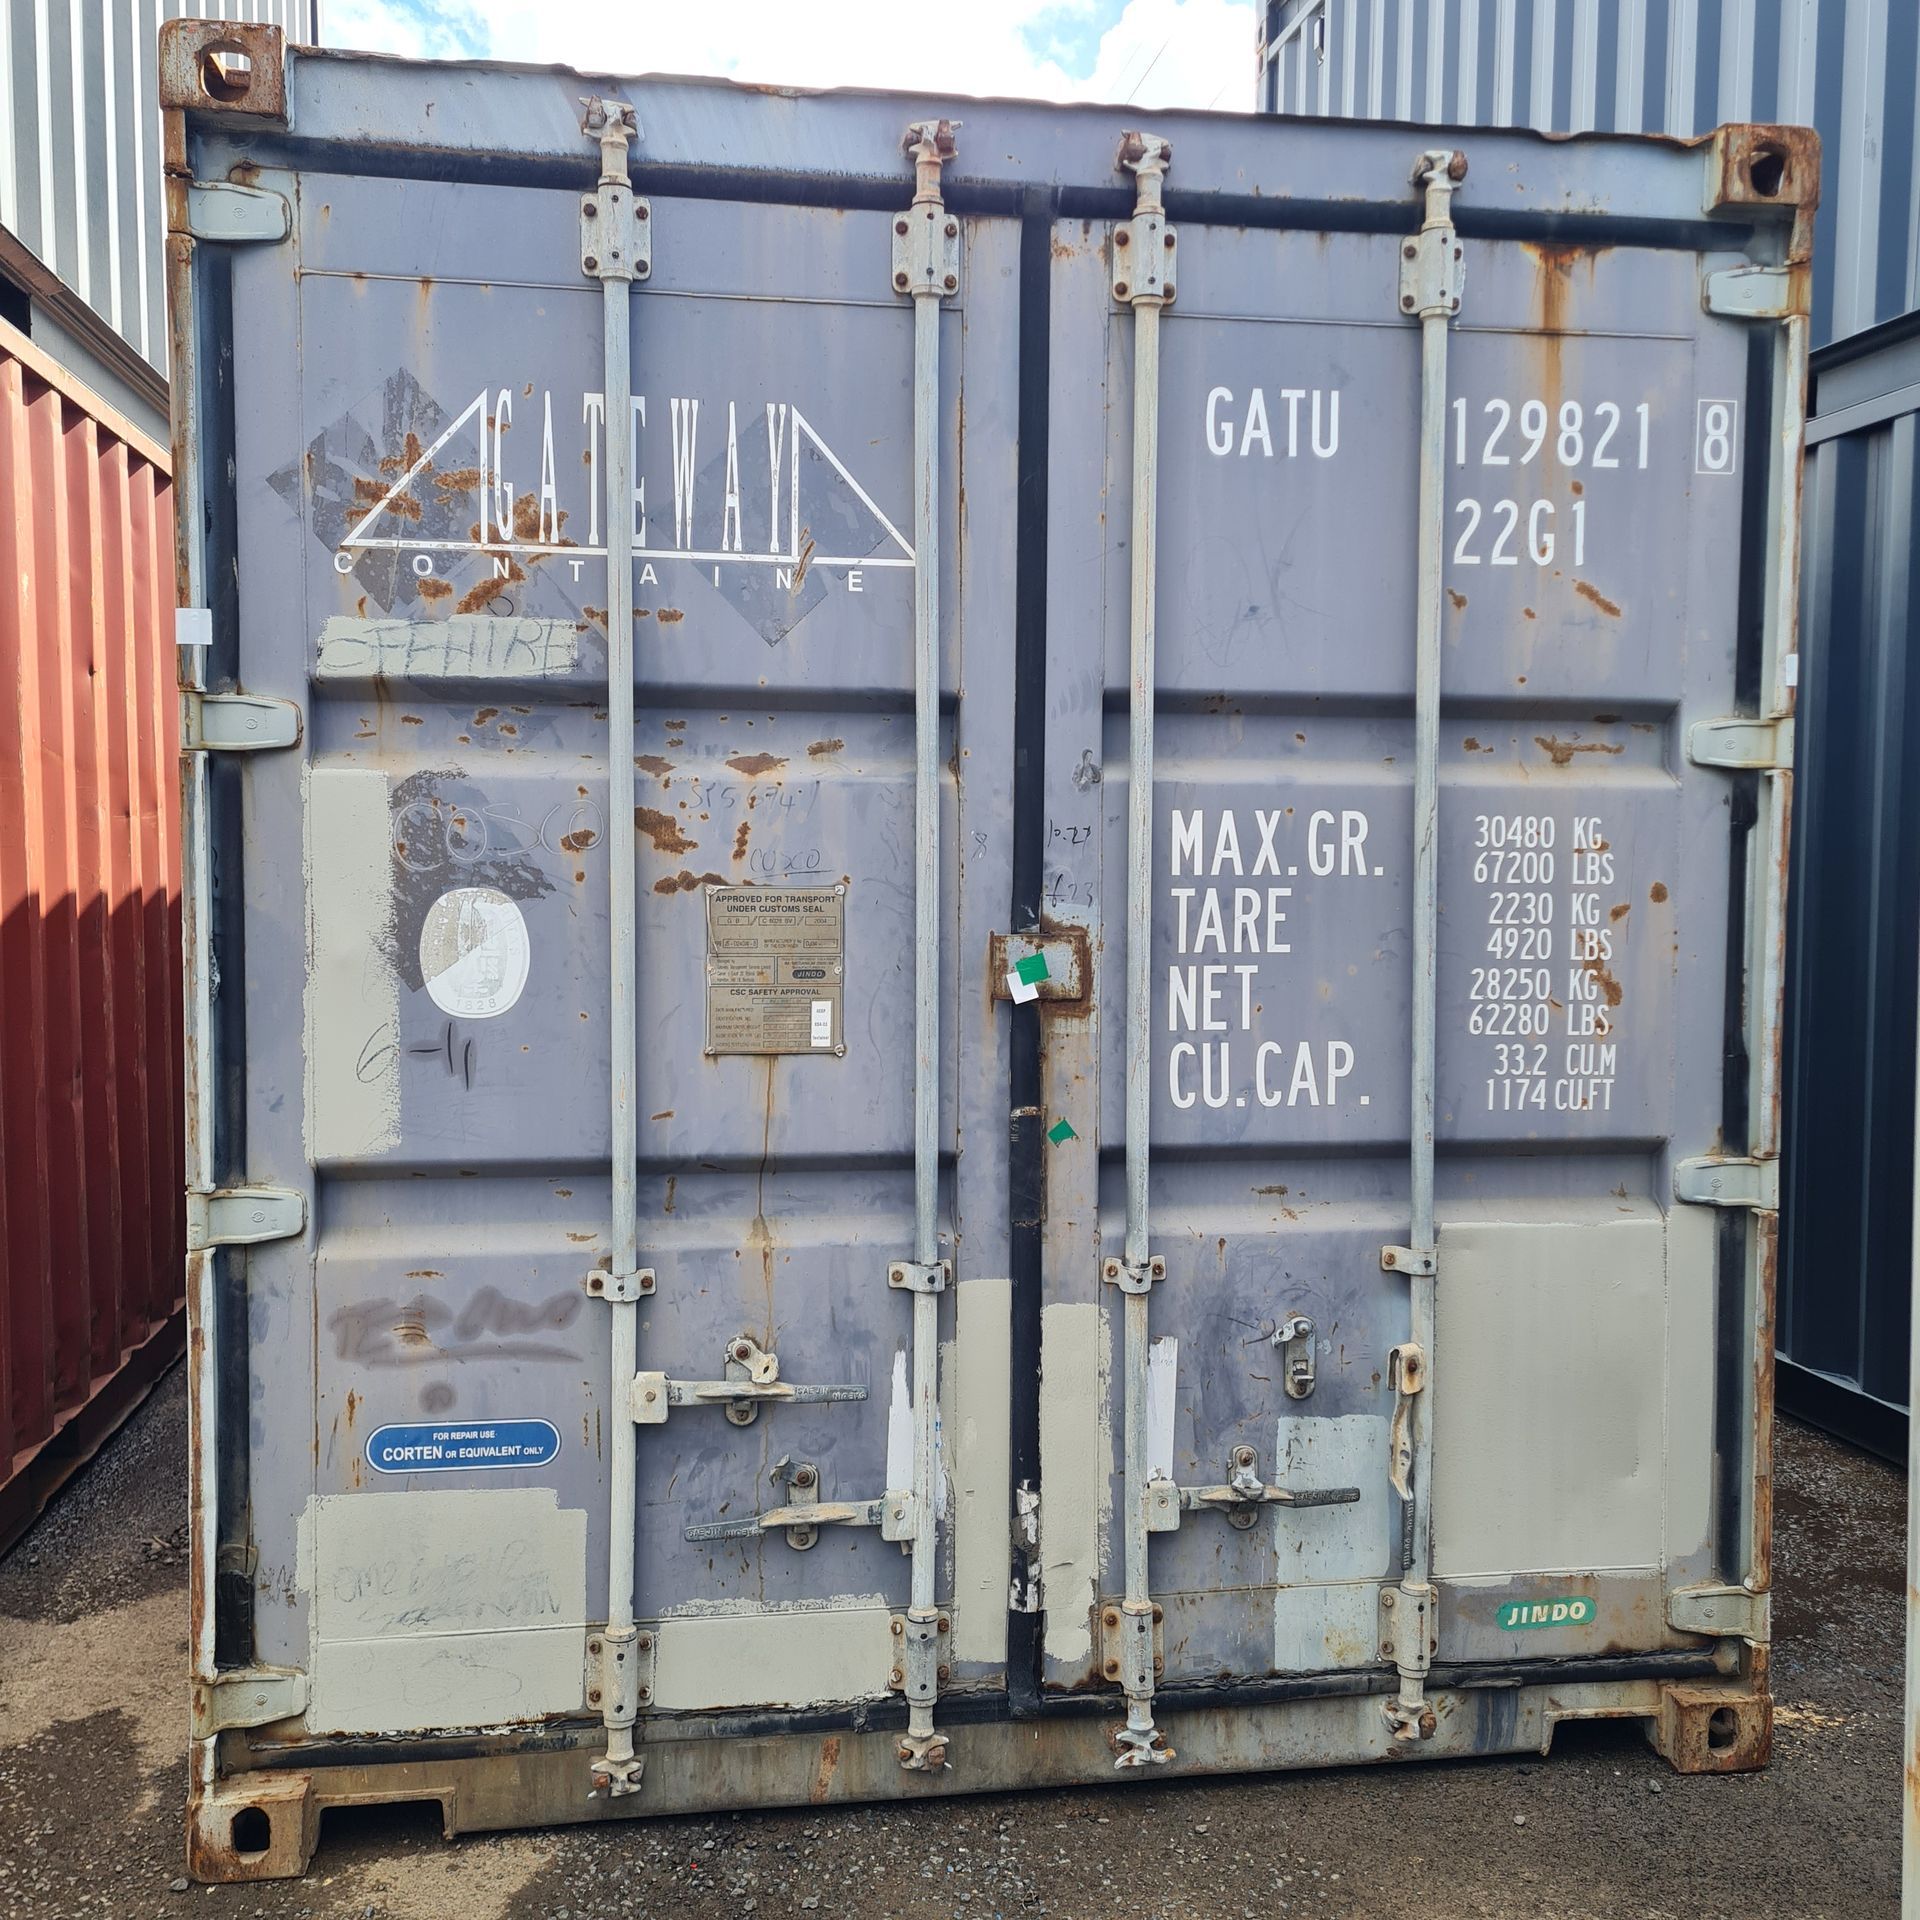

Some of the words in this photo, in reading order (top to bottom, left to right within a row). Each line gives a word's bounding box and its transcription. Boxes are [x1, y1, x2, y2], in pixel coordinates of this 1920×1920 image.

[1206, 386, 1340, 458] GATU
[1452, 397, 1649, 469] 129821
[1703, 404, 1729, 470] 8
[493, 388, 787, 553] GATEWAY
[1453, 498, 1586, 567] 22G1
[333, 552, 864, 593] CONTAINE
[1474, 815, 1556, 849] 30480
[1572, 815, 1603, 849] KG
[1473, 851, 1555, 885] 67200
[1571, 851, 1615, 886] LBS
[715, 895, 762, 903] APPROVED
[764, 895, 782, 903] FOR
[784, 895, 836, 903] TRANSPORT
[758, 905, 800, 913] CUSTOMS
[1488, 892, 1554, 926] 2230
[1570, 892, 1601, 926] KG
[1170, 886, 1293, 955] TARE
[1486, 927, 1553, 961] 4920
[1569, 927, 1613, 962] LBS
[1168, 964, 1260, 1032] NET
[1469, 967, 1552, 1001] 28250
[1568, 967, 1599, 1002] KG
[1468, 1002, 1550, 1036] 62280
[1566, 1003, 1610, 1037] LBS
[1493, 1043, 1548, 1077] 33.2
[1565, 1043, 1617, 1077] CU.M
[1486, 1078, 1547, 1111] 1174
[1554, 1078, 1616, 1112] CU.FT
[432, 1432, 449, 1441] FOR
[450, 1431, 478, 1440] REPAIR
[480, 1430, 495, 1439] USE
[382, 1446, 443, 1462] CORTEN
[445, 1451, 457, 1459] OR
[459, 1446, 522, 1458] EQUIVALENT
[523, 1446, 544, 1455] ONLY
[1507, 1601, 1586, 1626] JINDO
